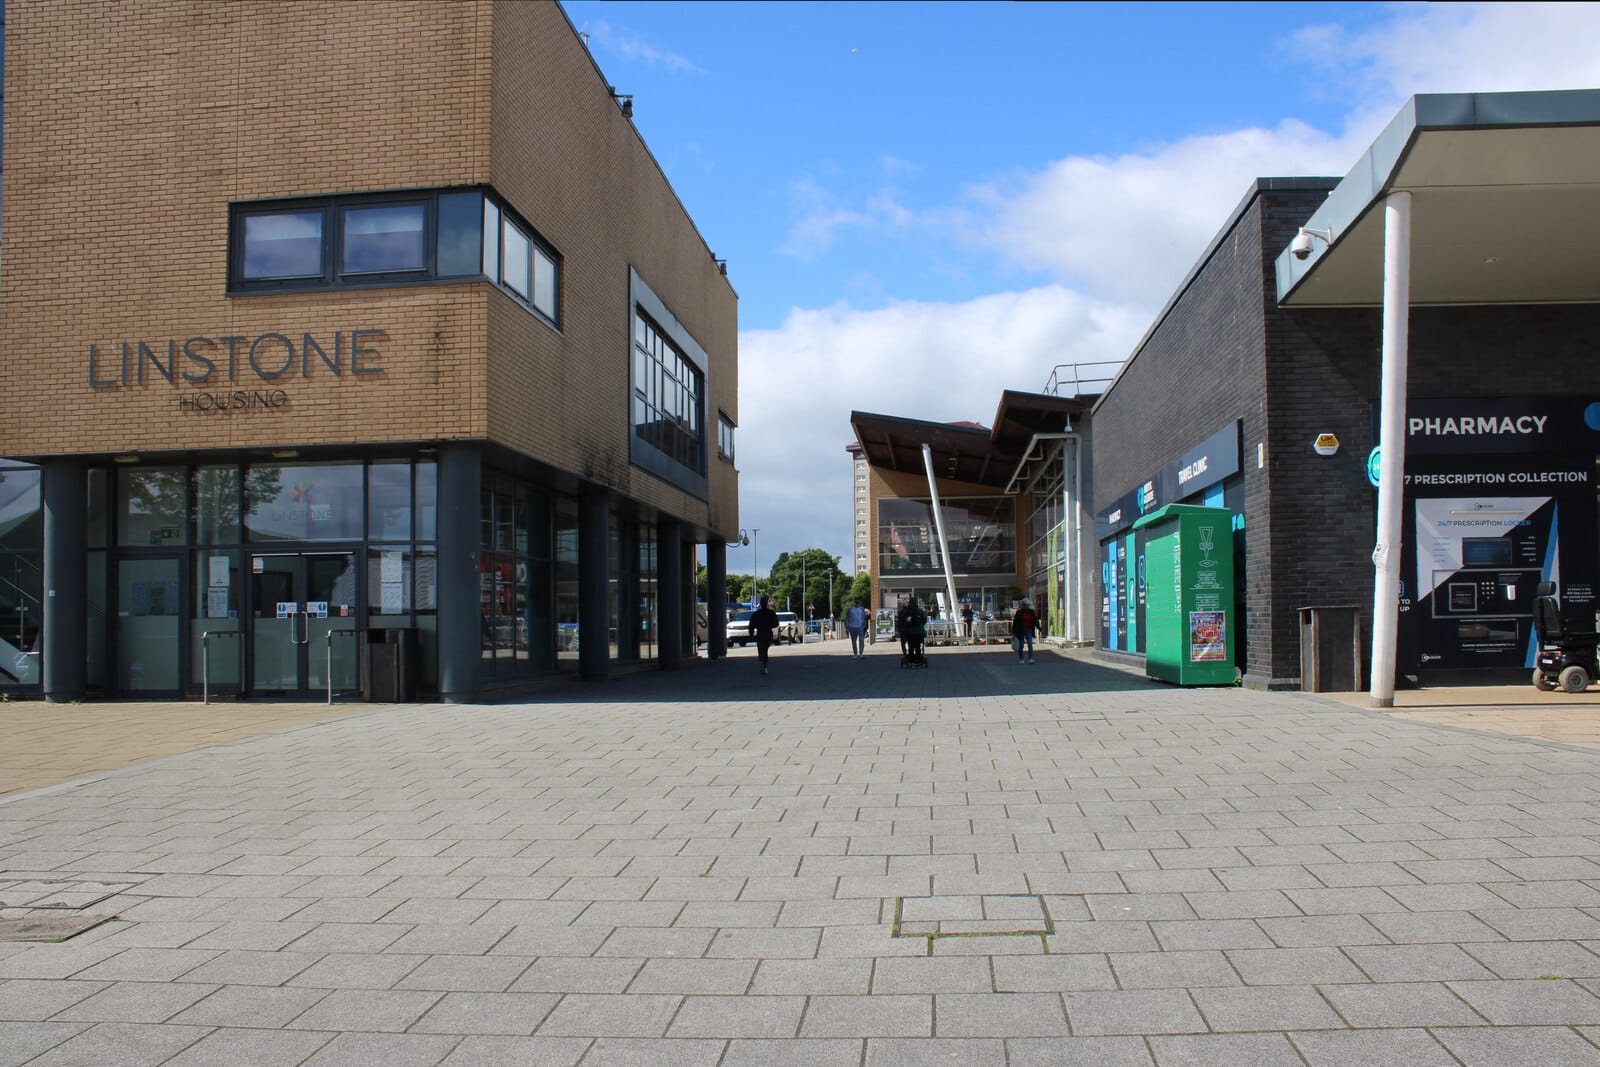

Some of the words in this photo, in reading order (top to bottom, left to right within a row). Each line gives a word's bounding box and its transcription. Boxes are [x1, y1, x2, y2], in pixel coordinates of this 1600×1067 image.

[89, 329, 385, 387] LINSTONE
[179, 389, 288, 411] HOUSING
[1409, 416, 1547, 435] PHARMACY
[1178, 466, 1193, 485] TRAVEL
[1193, 456, 1208, 477] CLINIC
[1415, 473, 1505, 484] PRESCRIPTION
[1508, 472, 1588, 483] COLLECTION
